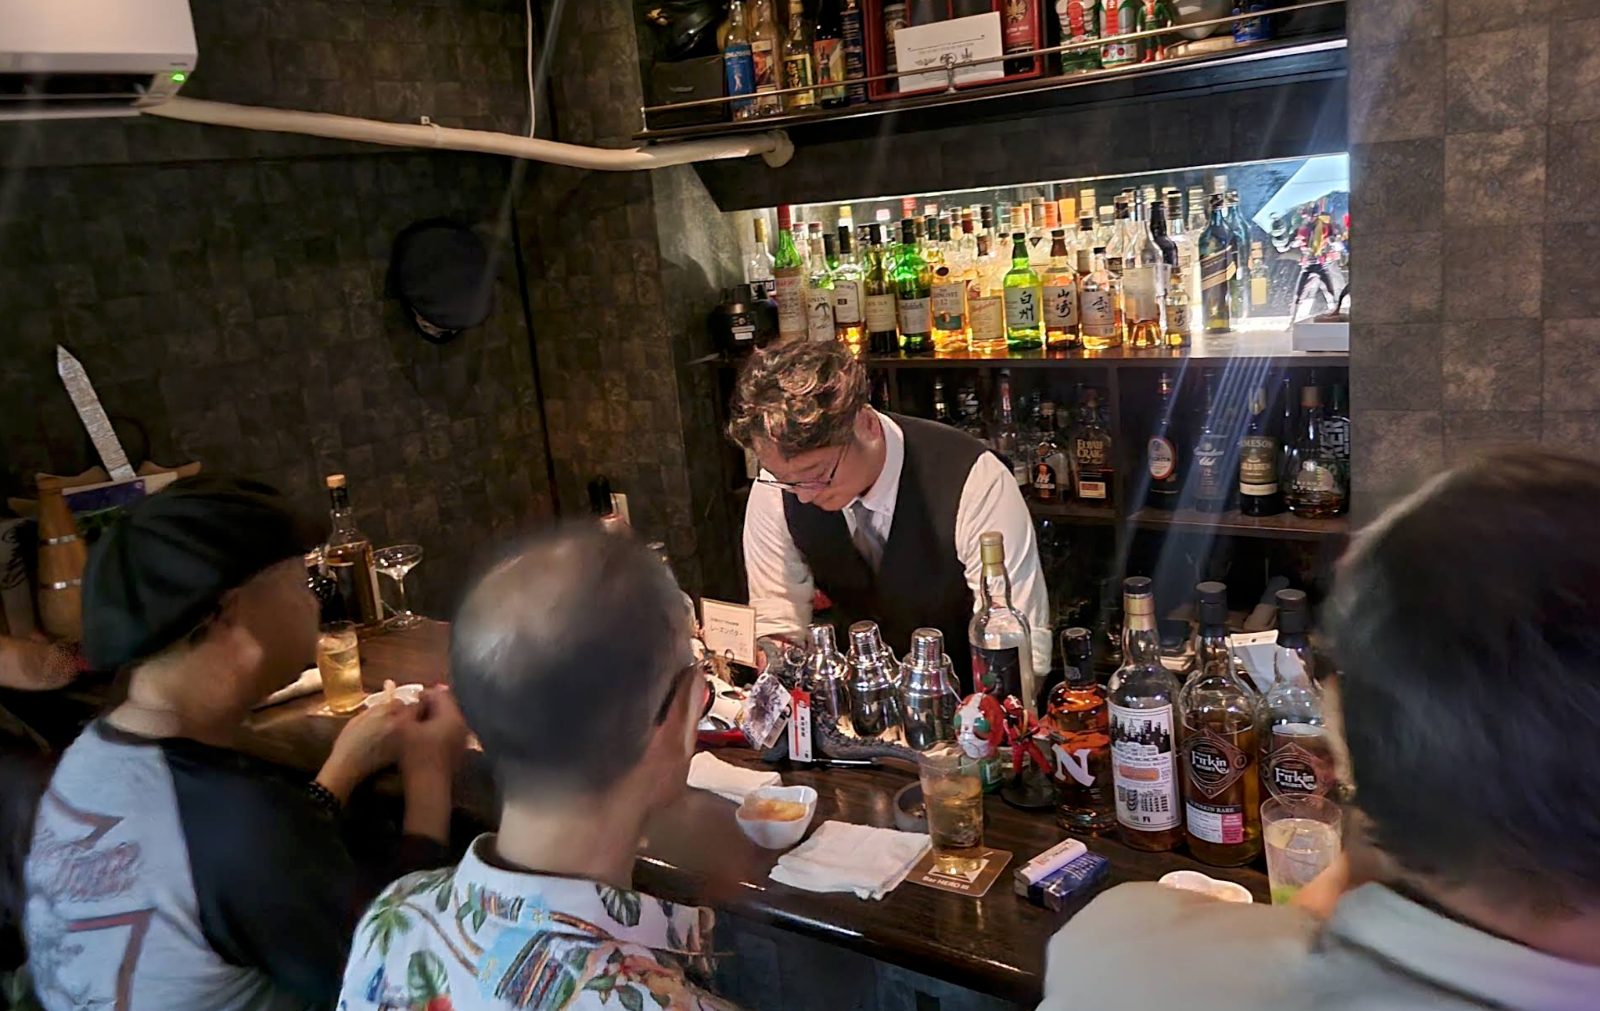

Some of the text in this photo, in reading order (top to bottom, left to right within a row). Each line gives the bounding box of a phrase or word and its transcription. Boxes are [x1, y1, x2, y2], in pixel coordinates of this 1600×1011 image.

[1019, 290, 1034, 321] 白州
[1051, 743, 1096, 787] N
[1191, 750, 1230, 774] Firkin
[1274, 767, 1317, 790] Firkin
[922, 875, 937, 883] Bar
